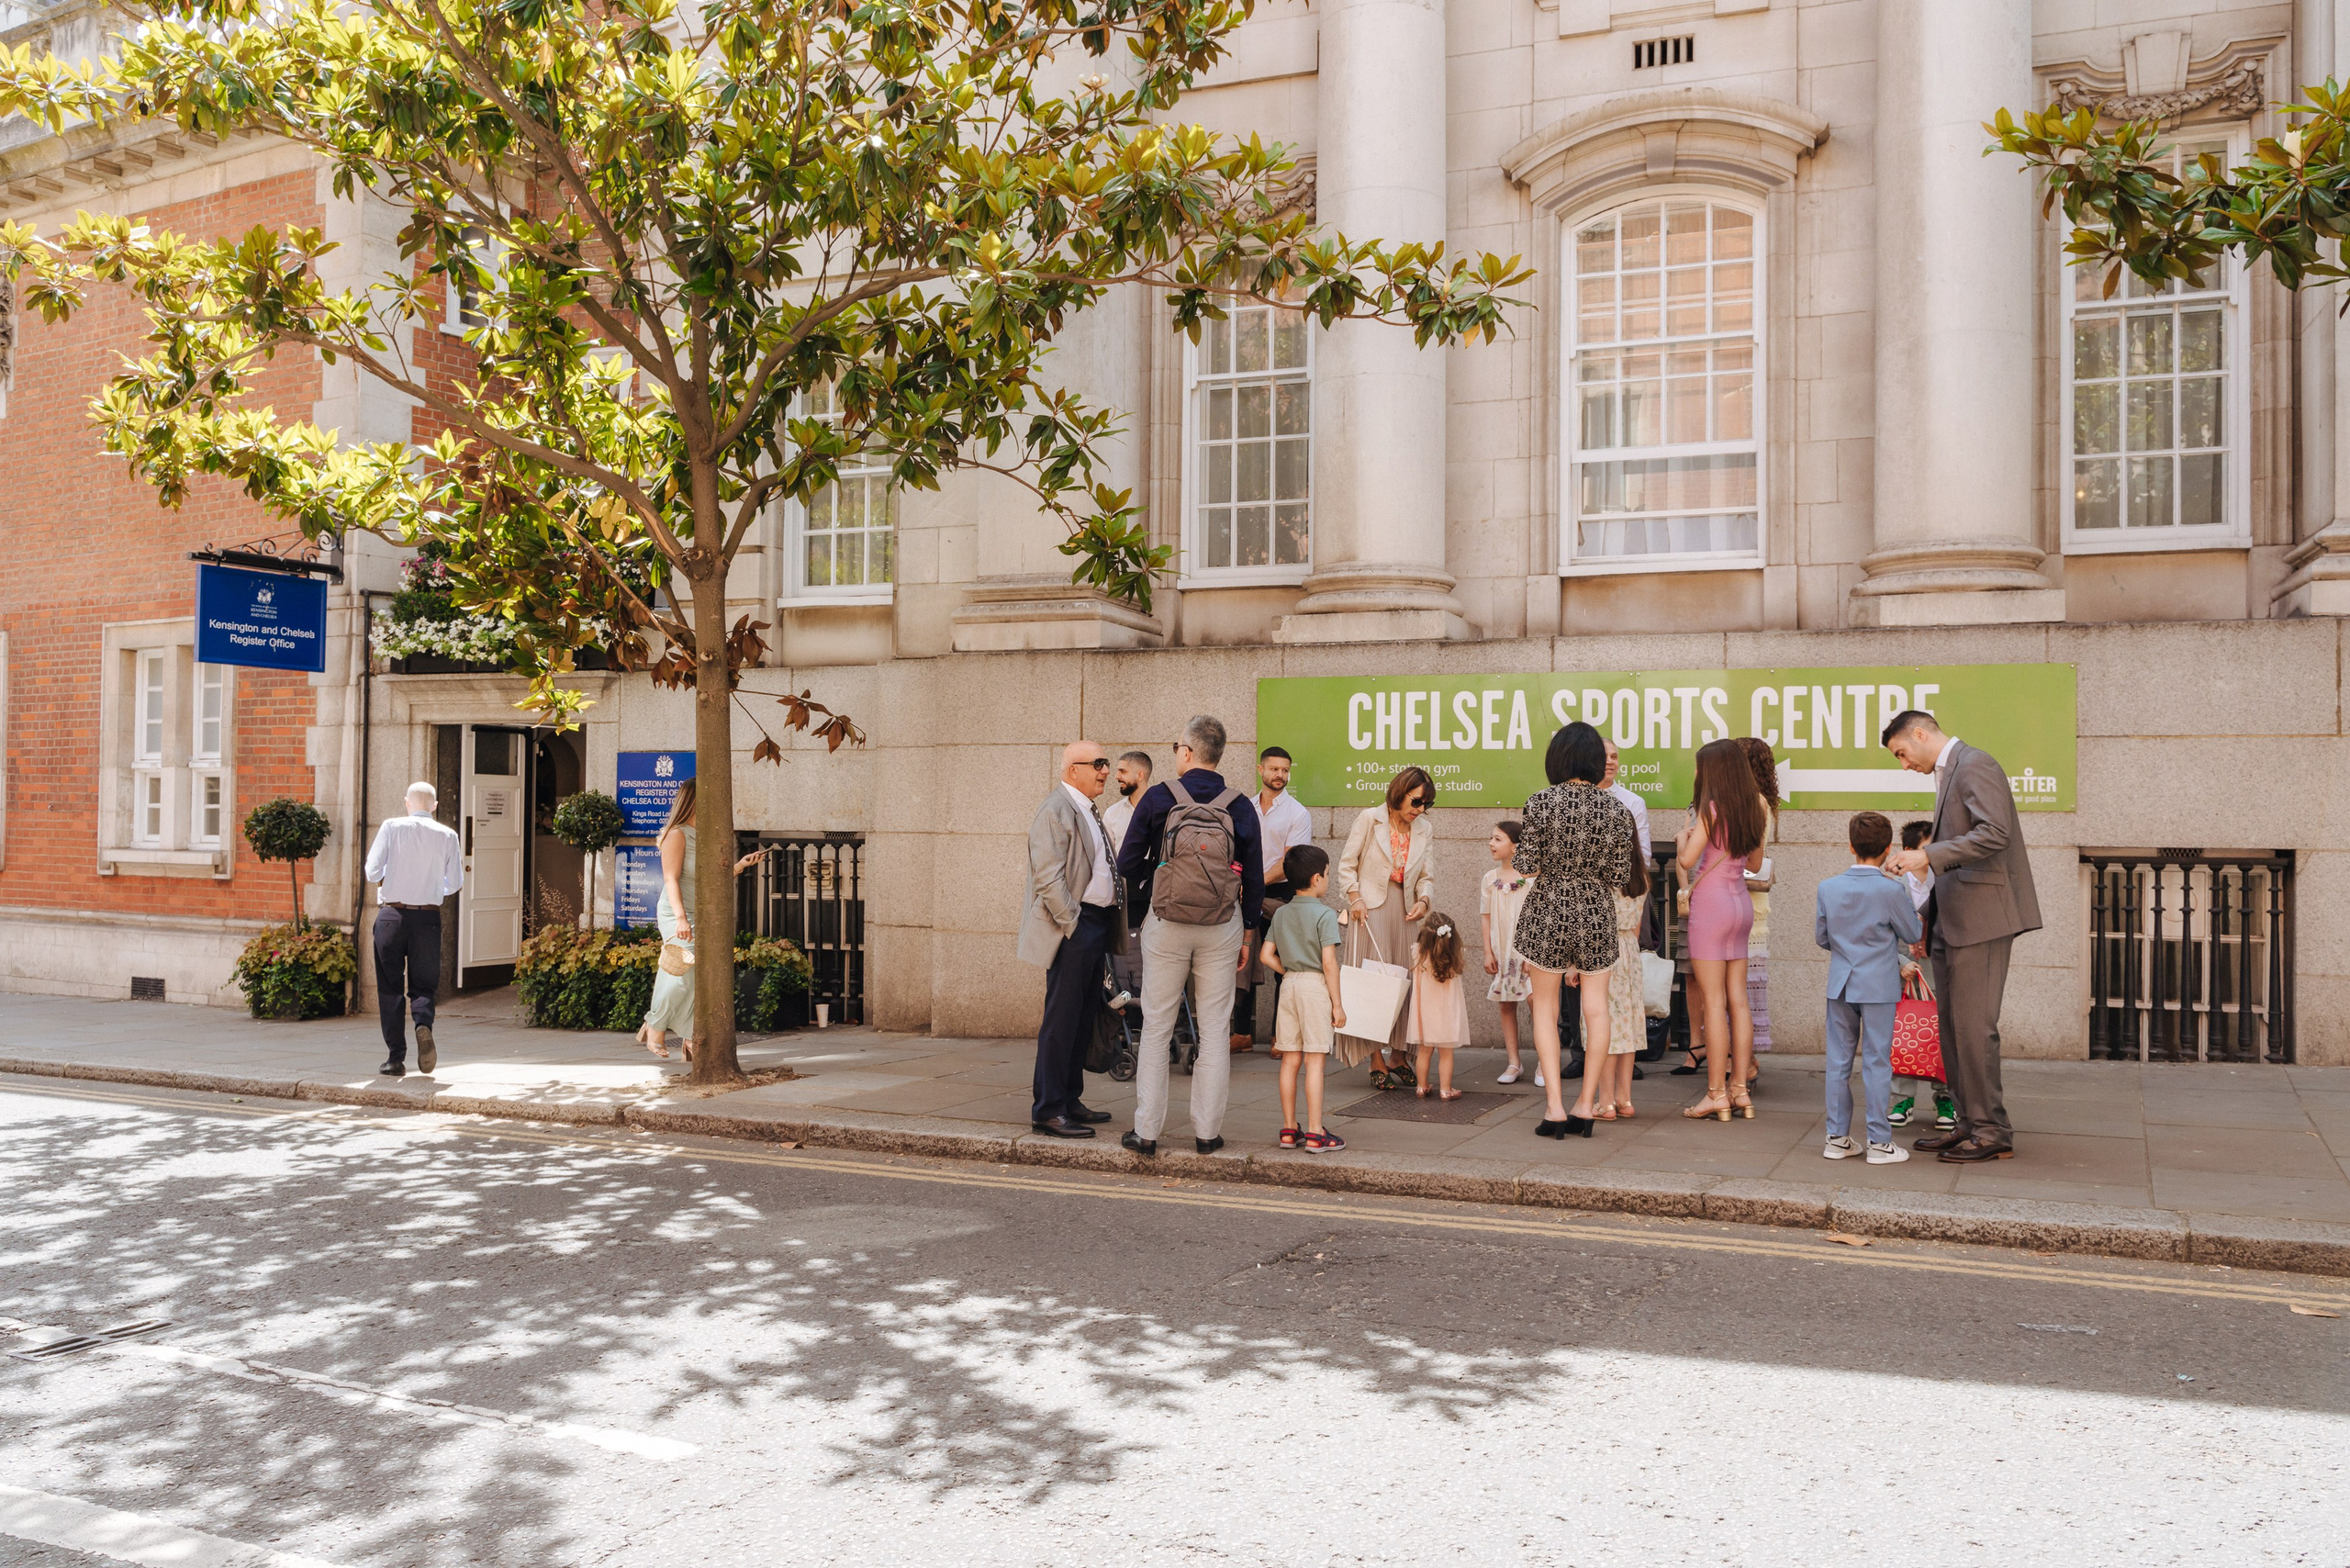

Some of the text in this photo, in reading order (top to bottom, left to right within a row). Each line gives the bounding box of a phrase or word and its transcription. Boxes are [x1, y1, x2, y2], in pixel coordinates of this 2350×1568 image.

[209, 619, 315, 638] Kensington and Chelsea
[230, 634, 296, 648] Register Office
[1348, 689, 1533, 750] CHELSEA
[1551, 687, 1729, 749] SPORTS
[1356, 762, 1386, 774] 100+
[1434, 765, 1460, 777] gym
[1631, 762, 1660, 777] pool
[1445, 779, 1483, 791] studio
[1629, 781, 1662, 791] more
[621, 904, 648, 913] Saturdays
